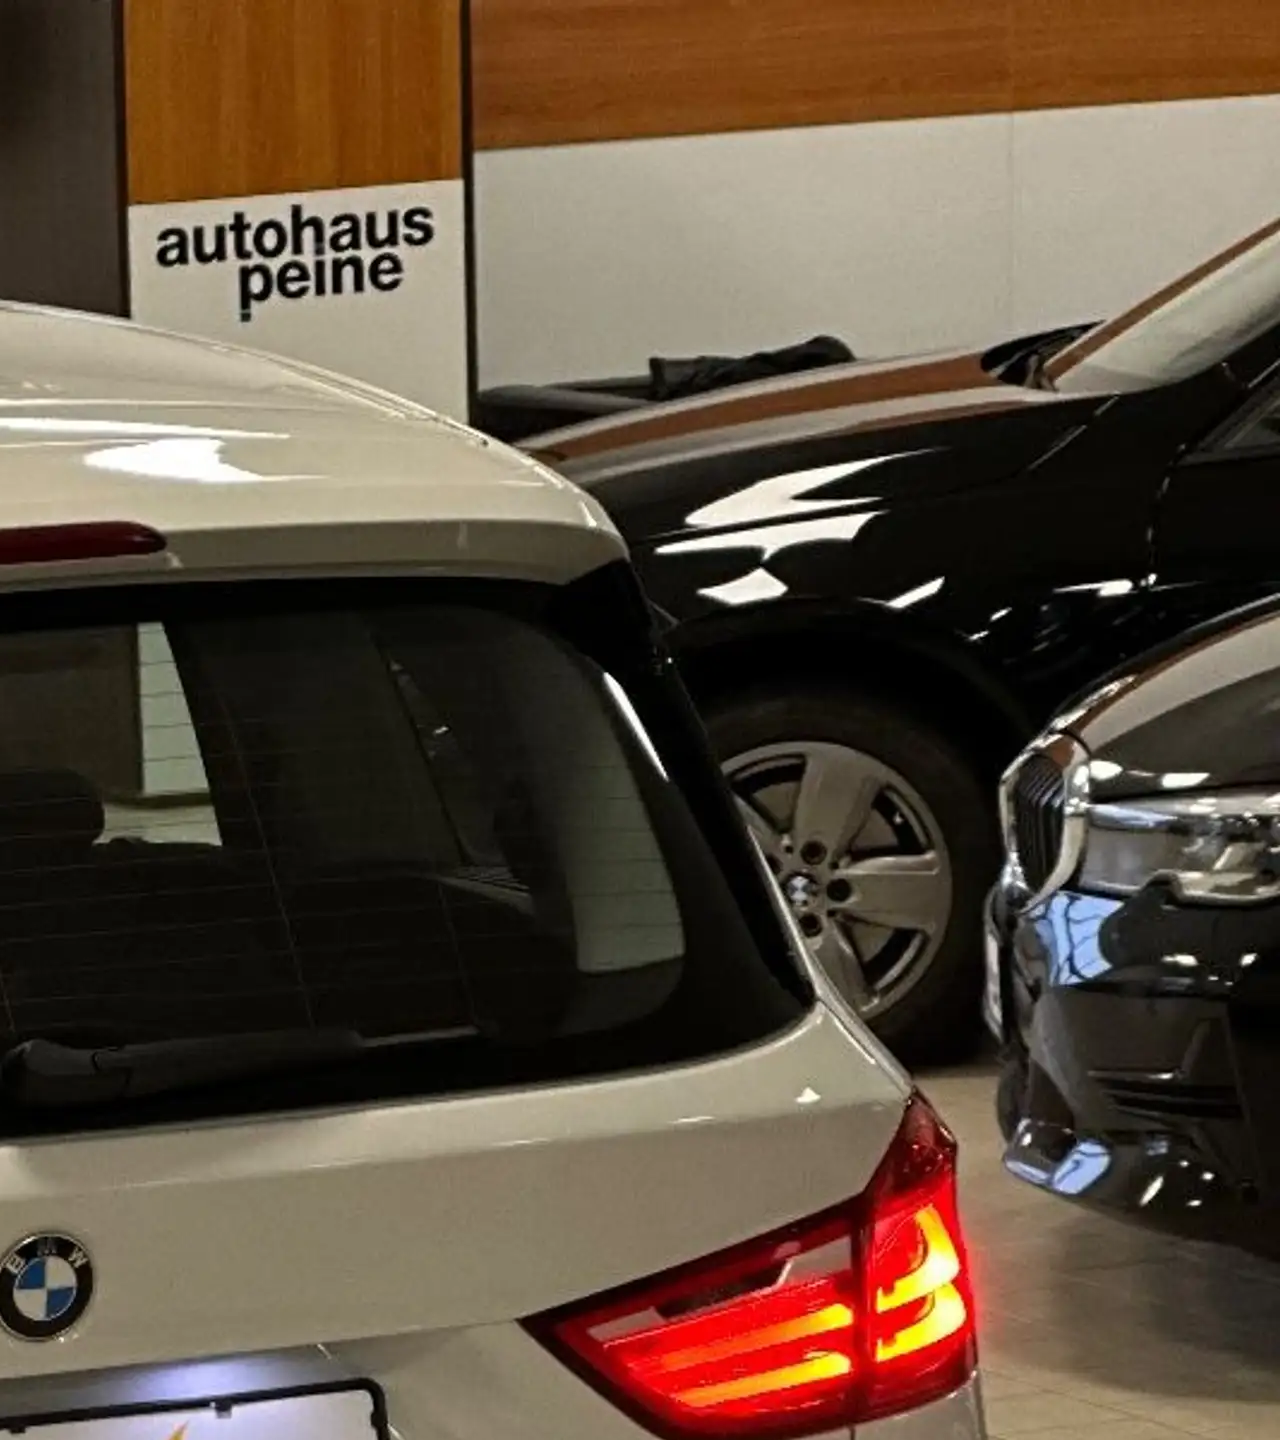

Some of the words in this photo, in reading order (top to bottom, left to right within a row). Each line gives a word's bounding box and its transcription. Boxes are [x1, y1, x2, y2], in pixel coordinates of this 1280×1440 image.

[155, 204, 435, 268] autohaus
[239, 244, 403, 322] peine
[5, 1238, 89, 1275] BMW
